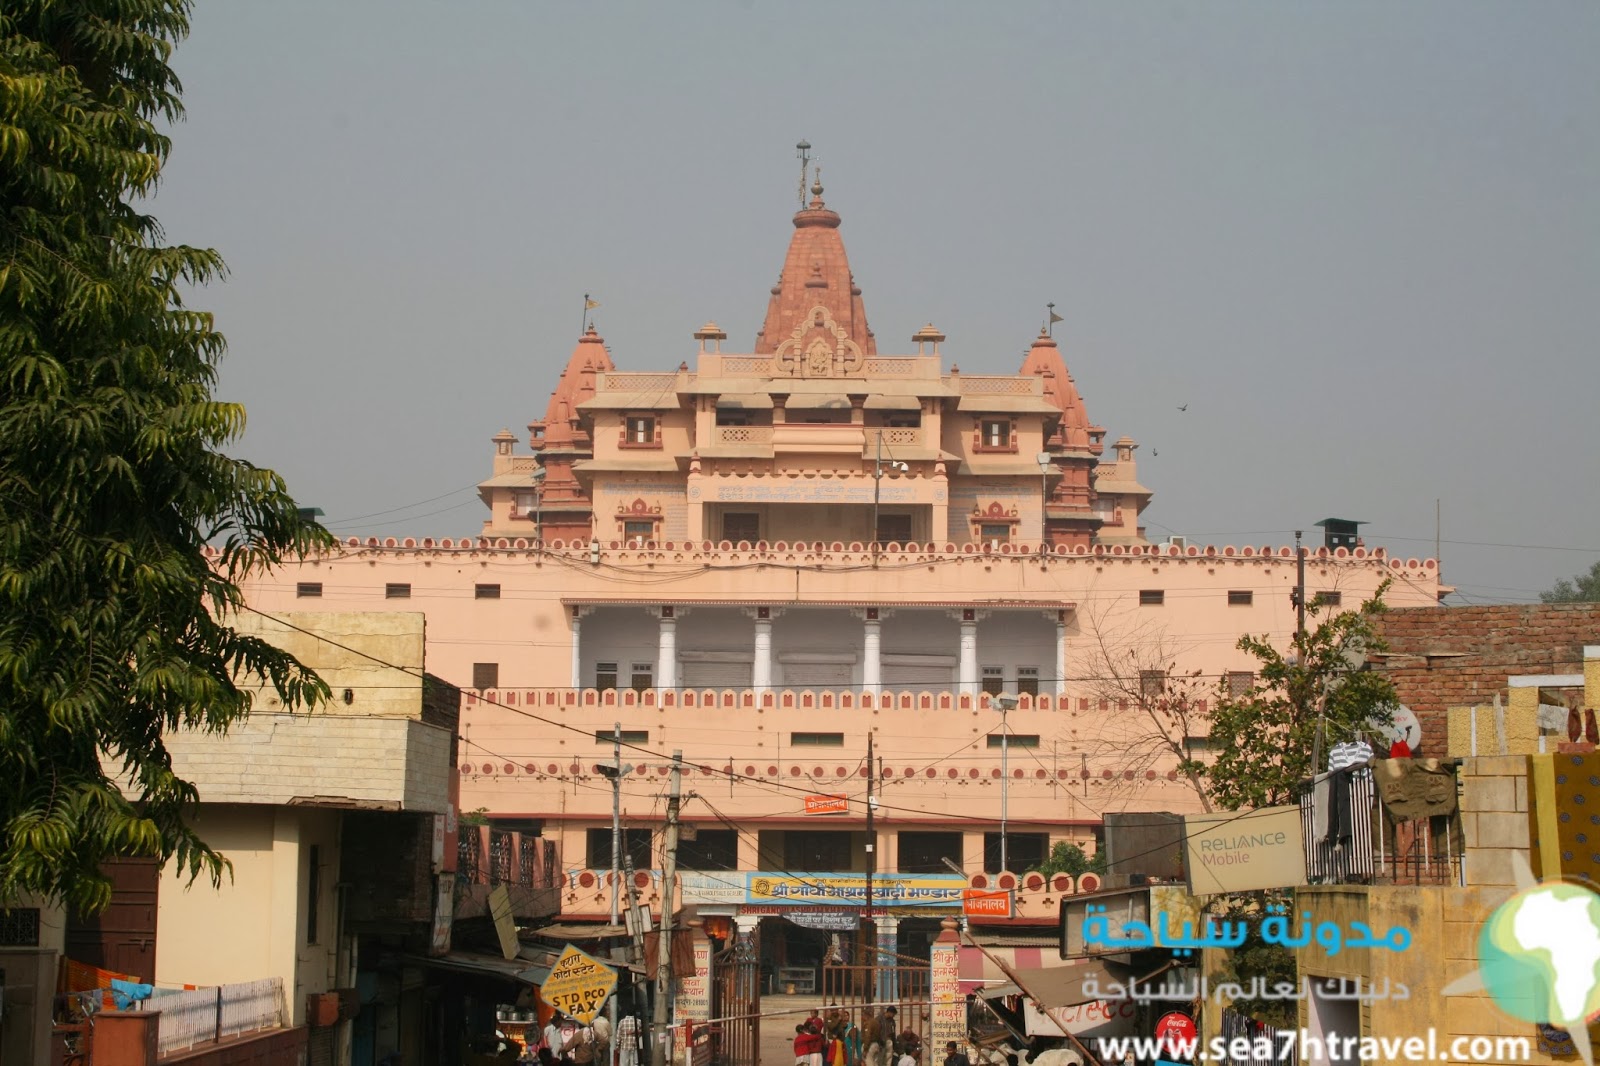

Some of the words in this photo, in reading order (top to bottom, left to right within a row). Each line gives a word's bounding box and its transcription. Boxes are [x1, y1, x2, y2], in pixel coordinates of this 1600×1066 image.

[1202, 850, 1250, 866] Mobile
[908, 887, 962, 900] भण्डार
[966, 892, 1006, 911] भोजनालय
[741, 905, 760, 914] SHRI
[584, 988, 606, 1001] PCO
[568, 1000, 598, 1016] FAX
